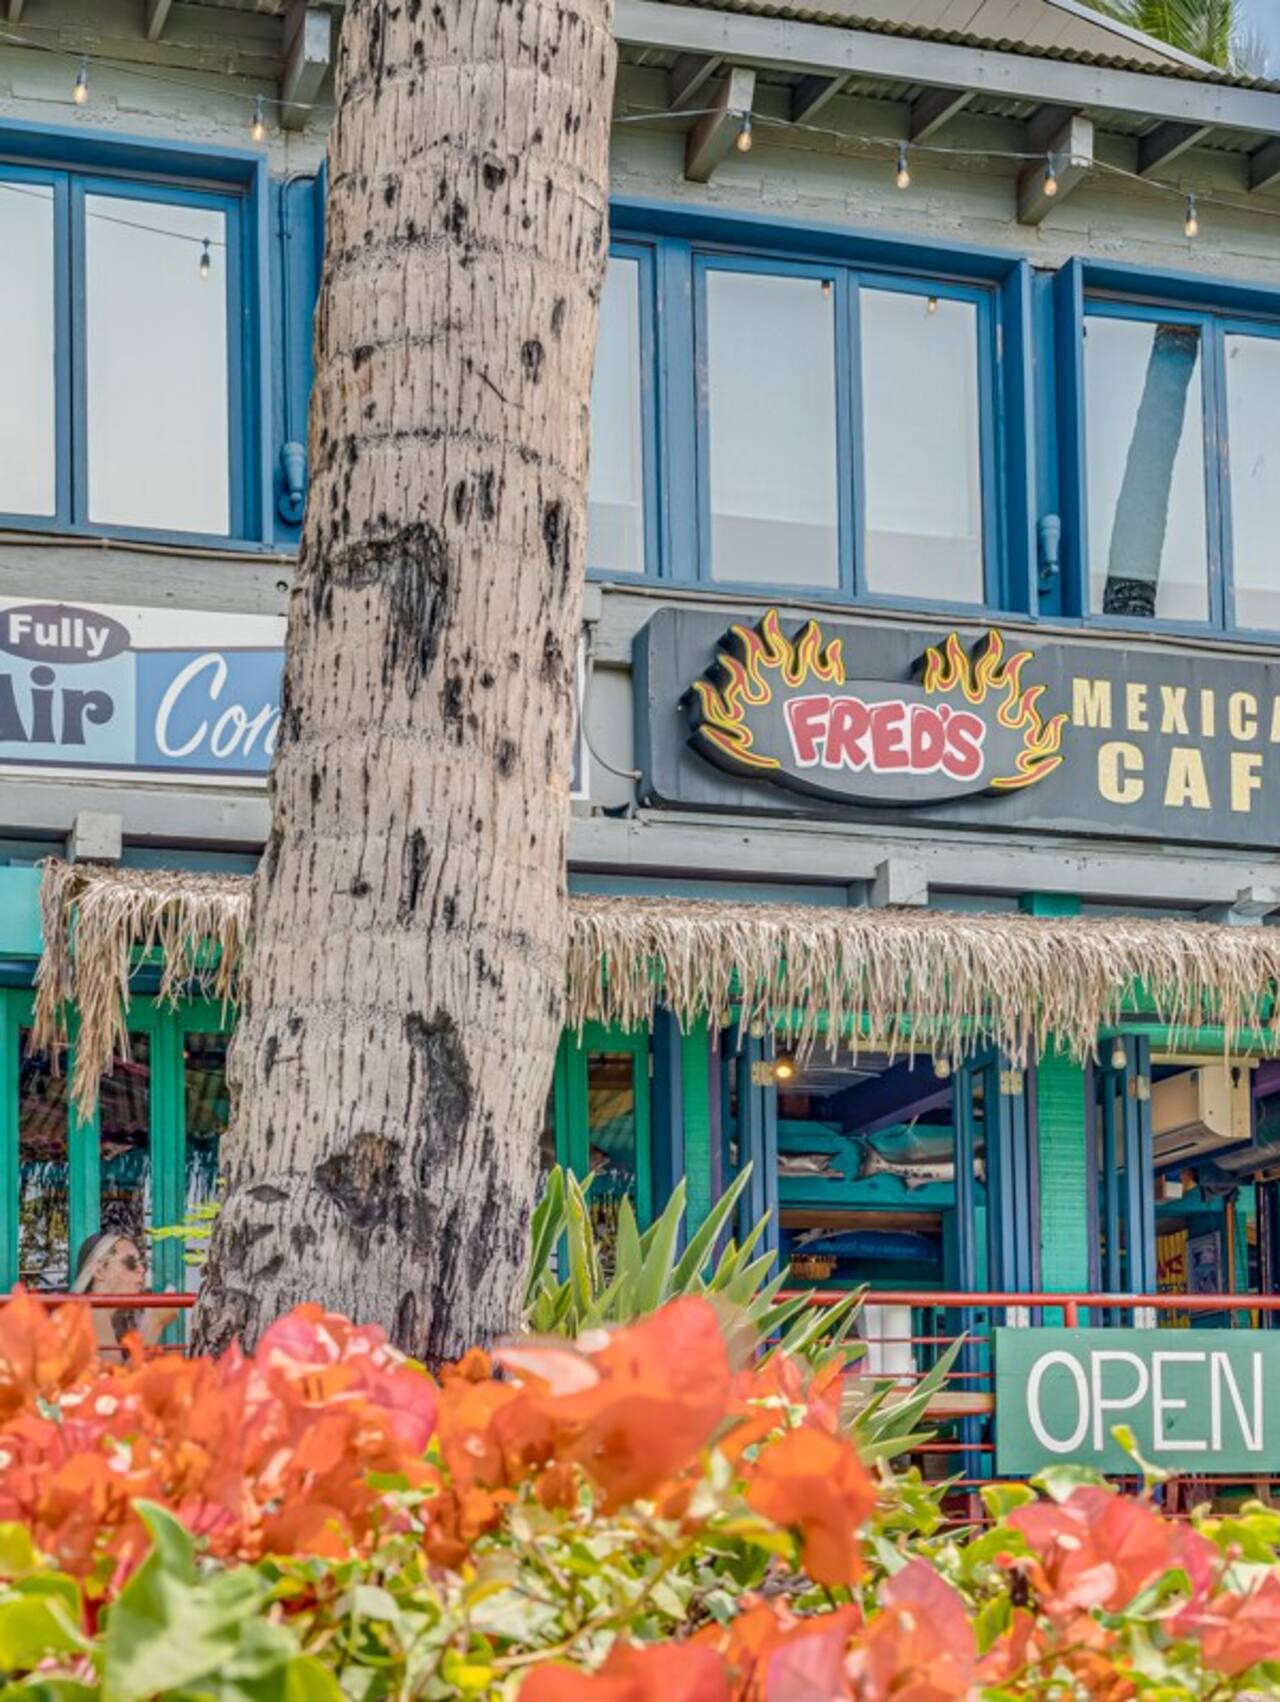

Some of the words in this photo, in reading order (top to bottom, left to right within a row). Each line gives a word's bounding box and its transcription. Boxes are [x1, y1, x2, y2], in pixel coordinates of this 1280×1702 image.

[8, 613, 110, 658] Fully
[784, 695, 986, 780] FRED'S
[1026, 1351, 1264, 1452] OPEN
